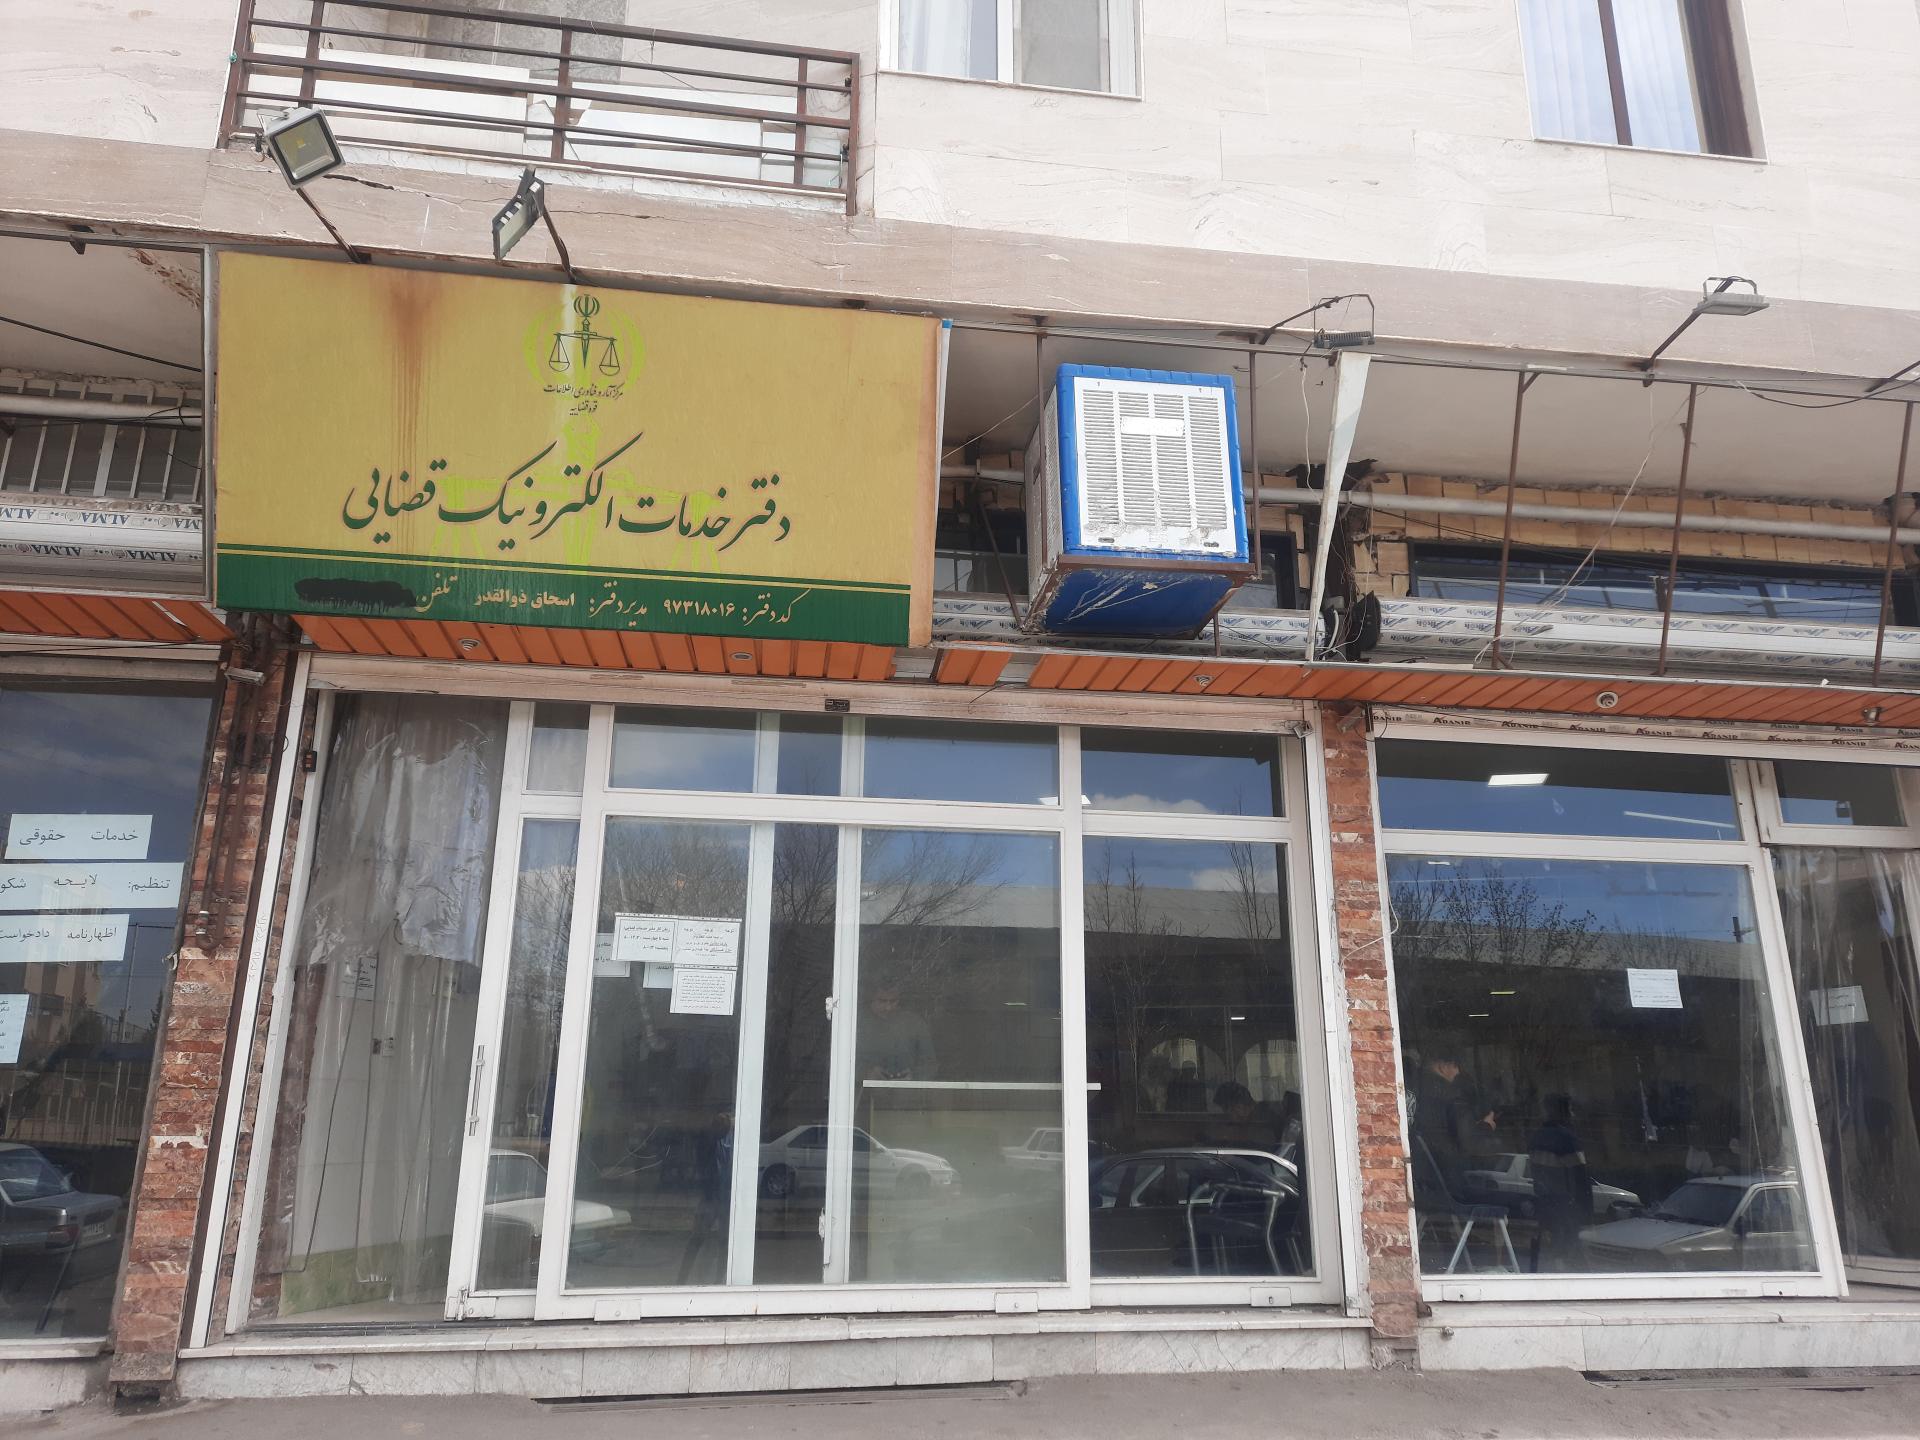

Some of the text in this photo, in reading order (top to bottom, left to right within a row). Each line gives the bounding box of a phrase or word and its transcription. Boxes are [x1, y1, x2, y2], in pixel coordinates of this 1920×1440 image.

[438, 431, 643, 551] الکترونیک
[0, 506, 37, 519] ALM
[81, 511, 131, 526] ALMA
[618, 486, 733, 539] خدمات
[718, 473, 791, 552] دفتر
[31, 543, 177, 562] ALMA ALMA
[414, 572, 459, 613] تلفن
[473, 588, 527, 608] ذوالقدر
[530, 592, 575, 609] اسحاق
[622, 599, 648, 627] مدیر
[663, 598, 736, 617] ۹۷۳۱۸۰۱۶
[776, 587, 811, 624] کد
[19, 828, 139, 847] خدمات حقوقی
[53, 873, 98, 889] لایحه
[127, 876, 170, 893] تنظیم:
[67, 926, 117, 943] اظهارنامه
